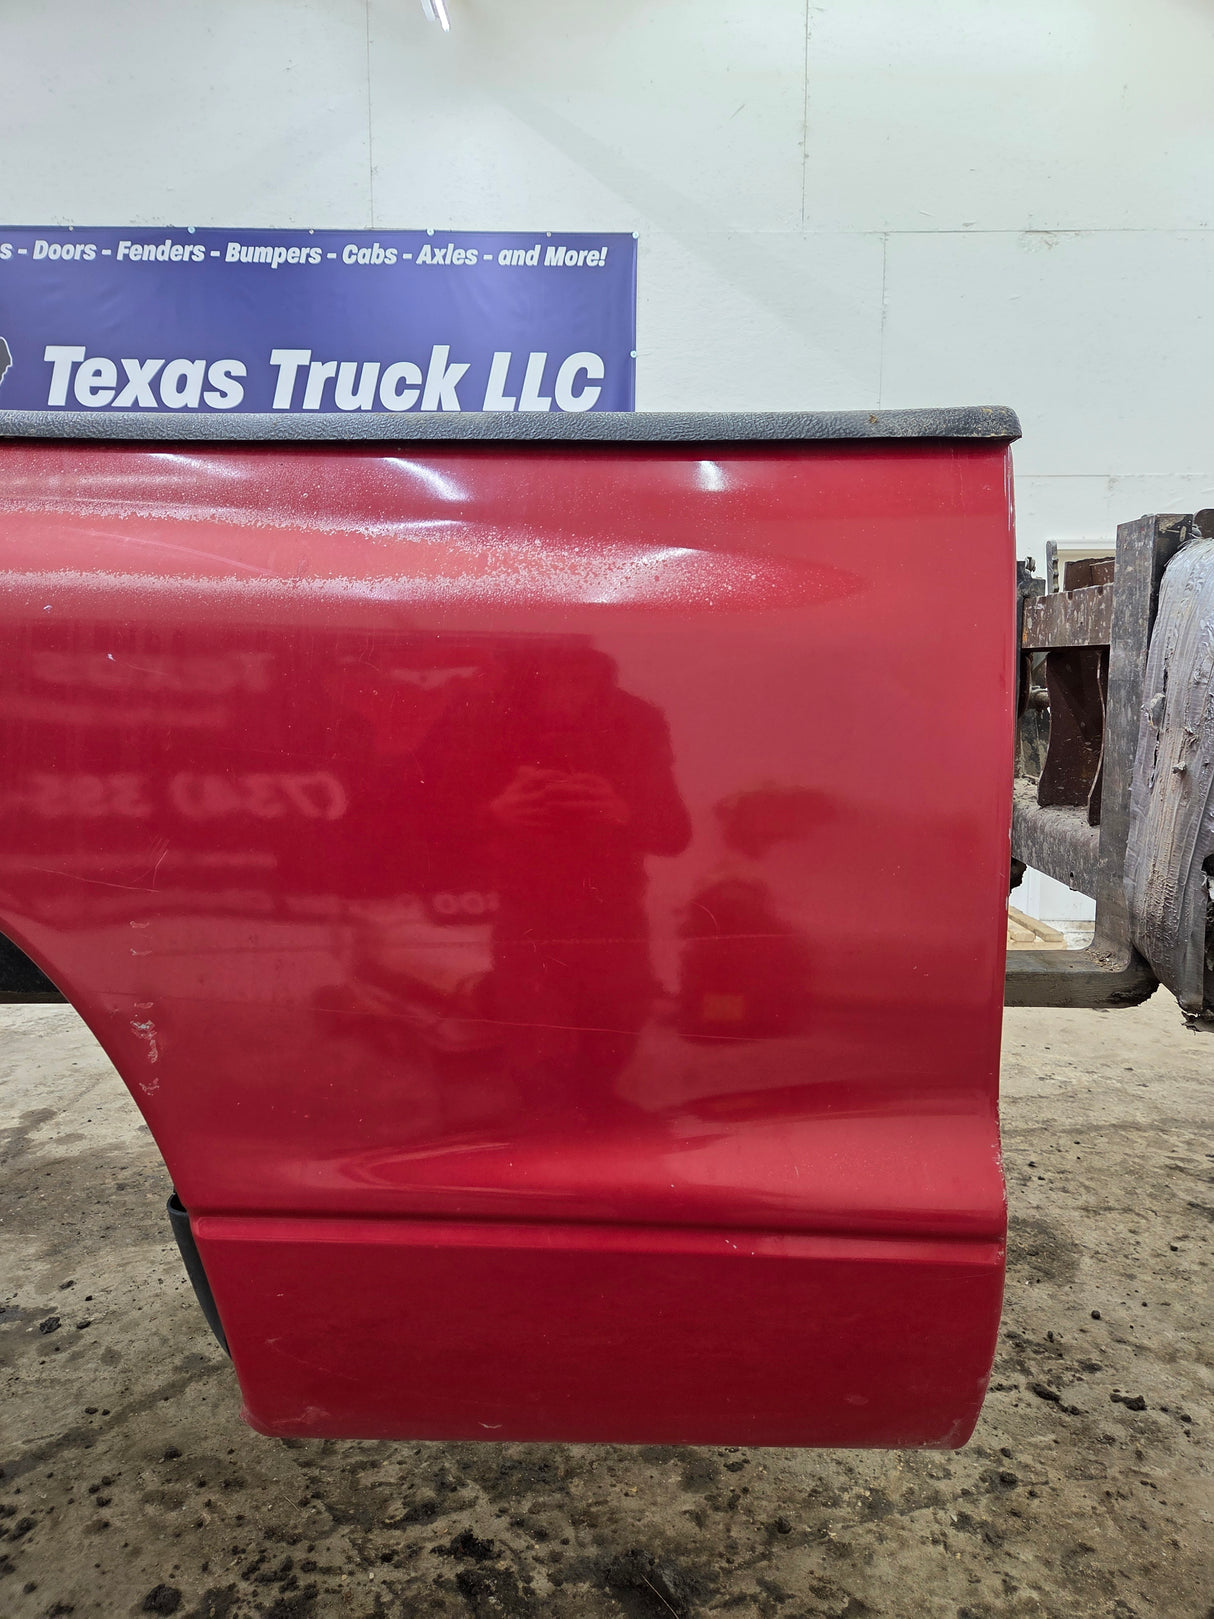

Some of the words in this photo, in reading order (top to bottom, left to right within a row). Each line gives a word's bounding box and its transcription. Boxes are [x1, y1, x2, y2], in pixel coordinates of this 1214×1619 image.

[33, 240, 97, 260] Doors
[116, 239, 206, 262] Fenders
[225, 242, 322, 269] Bumpers
[342, 243, 398, 265] Cabs
[416, 243, 479, 265] Axles
[498, 244, 542, 266] and
[543, 246, 608, 267] More!
[44, 345, 247, 409] Texas
[269, 344, 472, 412] Truck
[482, 351, 606, 413] LLC
